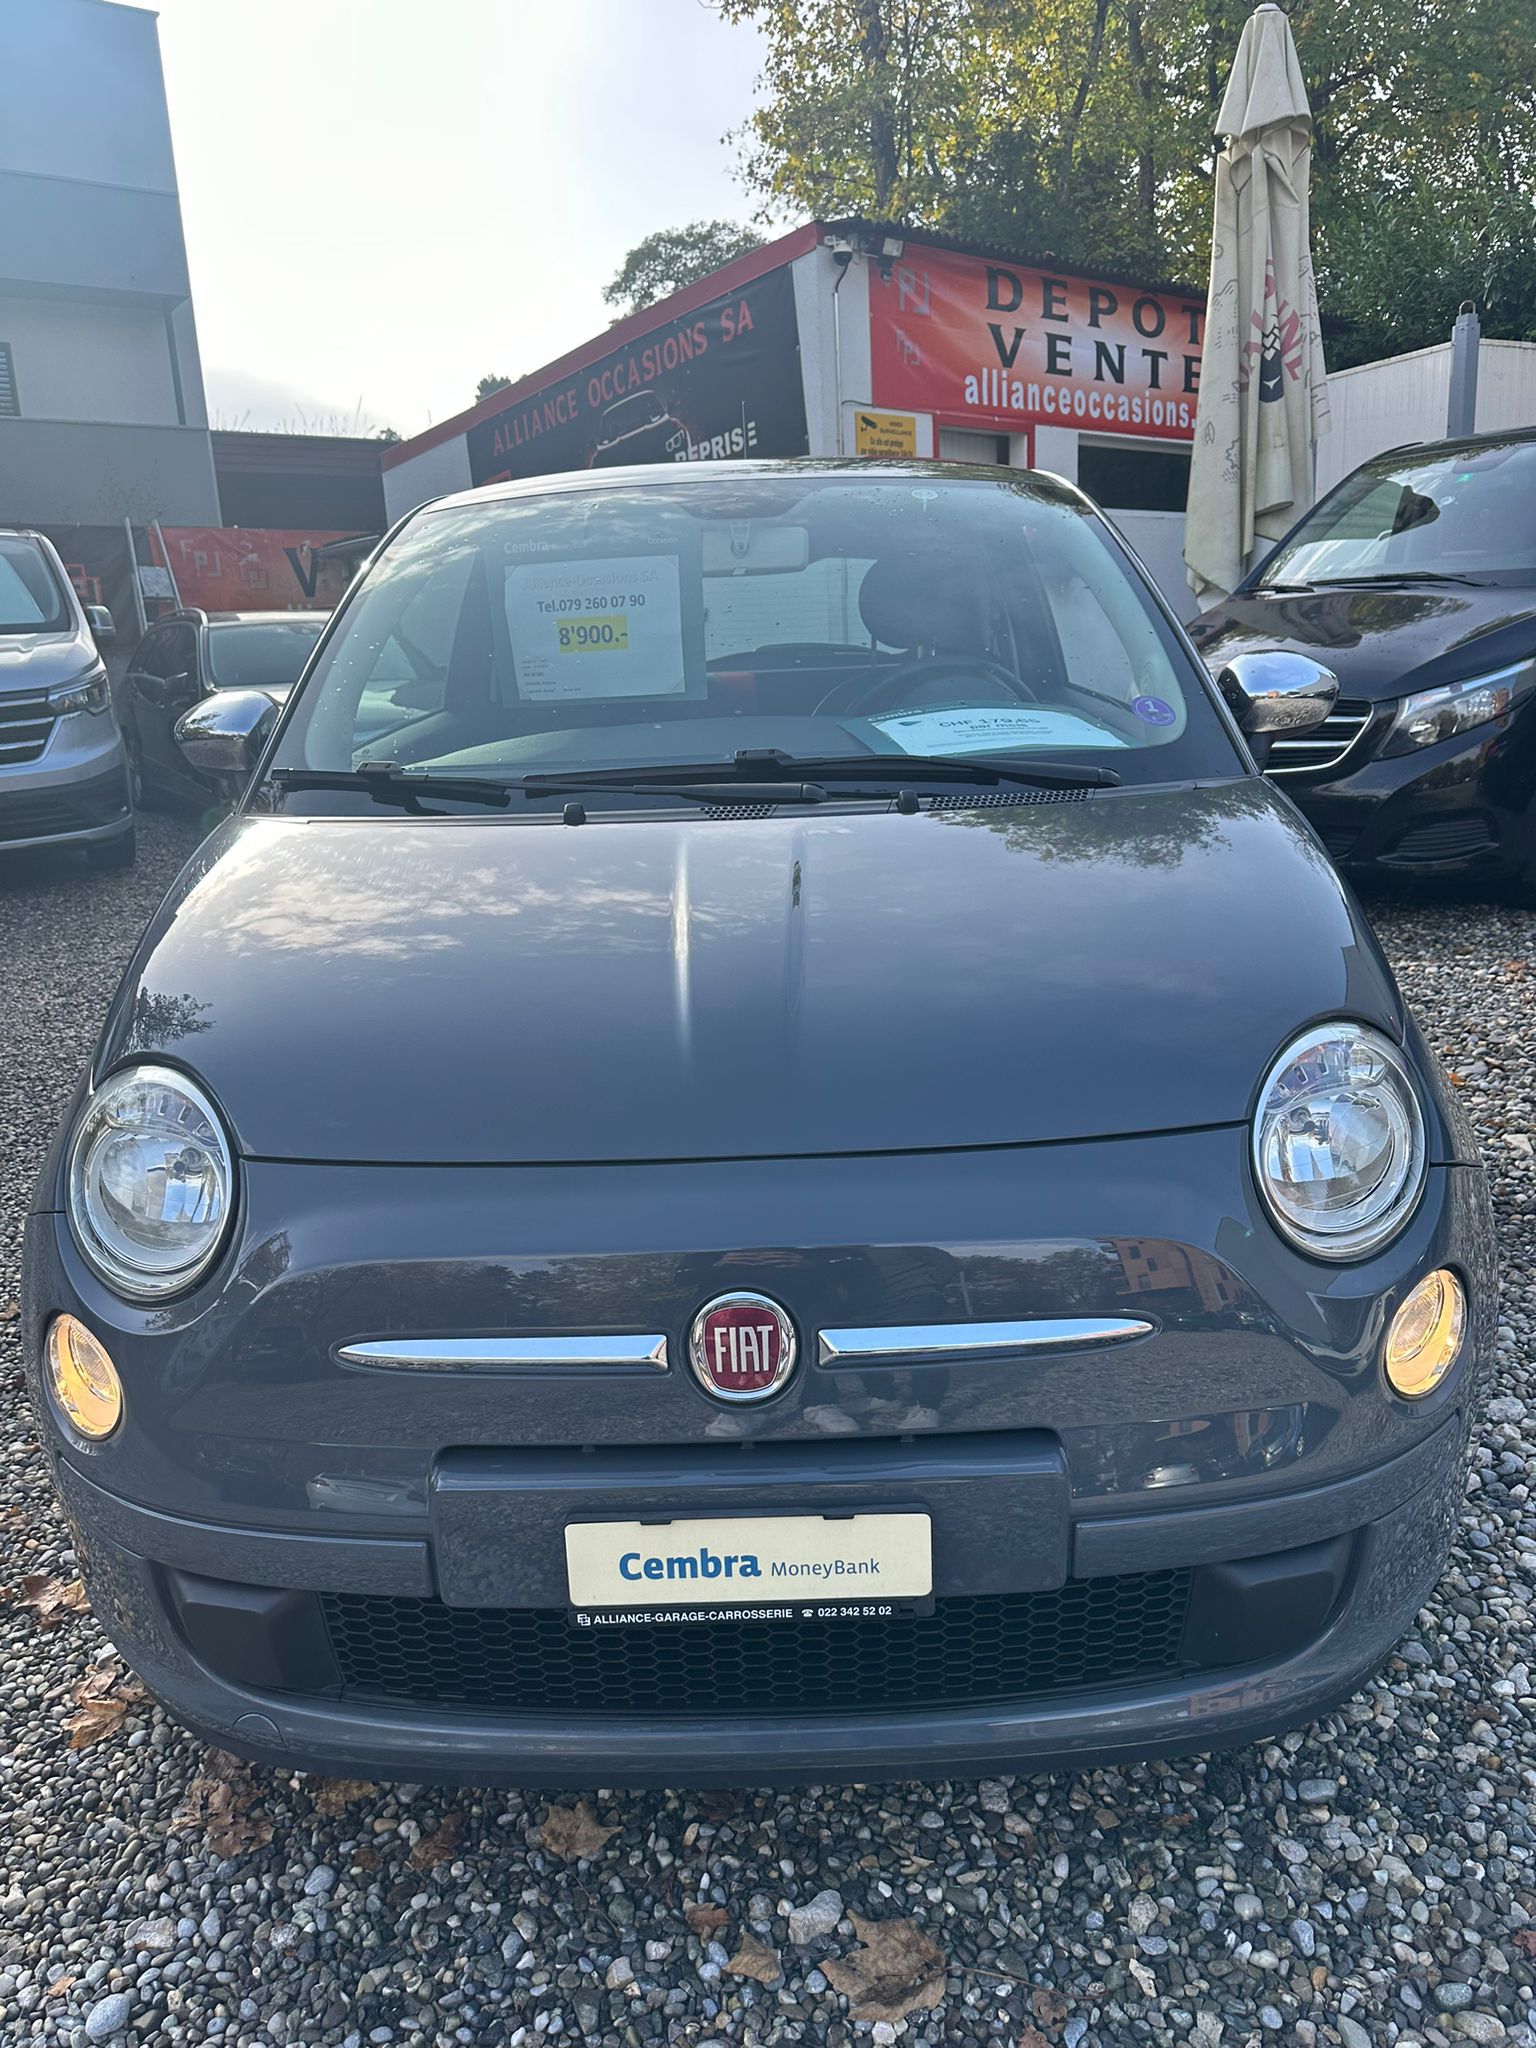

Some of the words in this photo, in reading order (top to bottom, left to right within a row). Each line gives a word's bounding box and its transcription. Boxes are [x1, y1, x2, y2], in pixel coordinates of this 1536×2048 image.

[986, 322, 1202, 394] VENTE
[493, 389, 579, 457] ALLIANCE
[587, 321, 708, 408] OCCASIONS
[719, 299, 754, 343] SA
[504, 539, 549, 554] Cembra
[536, 599, 582, 613] Tel.079
[584, 597, 608, 610] 260
[610, 595, 626, 608] 07
[629, 594, 646, 607] 90
[559, 624, 628, 646] 8'900.-
[713, 1324, 774, 1373] FIAT
[618, 1548, 763, 1581] Cembra
[771, 1558, 880, 1580] MoneyBank
[593, 1608, 793, 1625] ALLIANCE-GARAGE-CARROSSERIE
[817, 1607, 838, 1618] 022
[839, 1606, 861, 1617] 342
[863, 1606, 877, 1616] 52
[878, 1605, 892, 1616] 02
